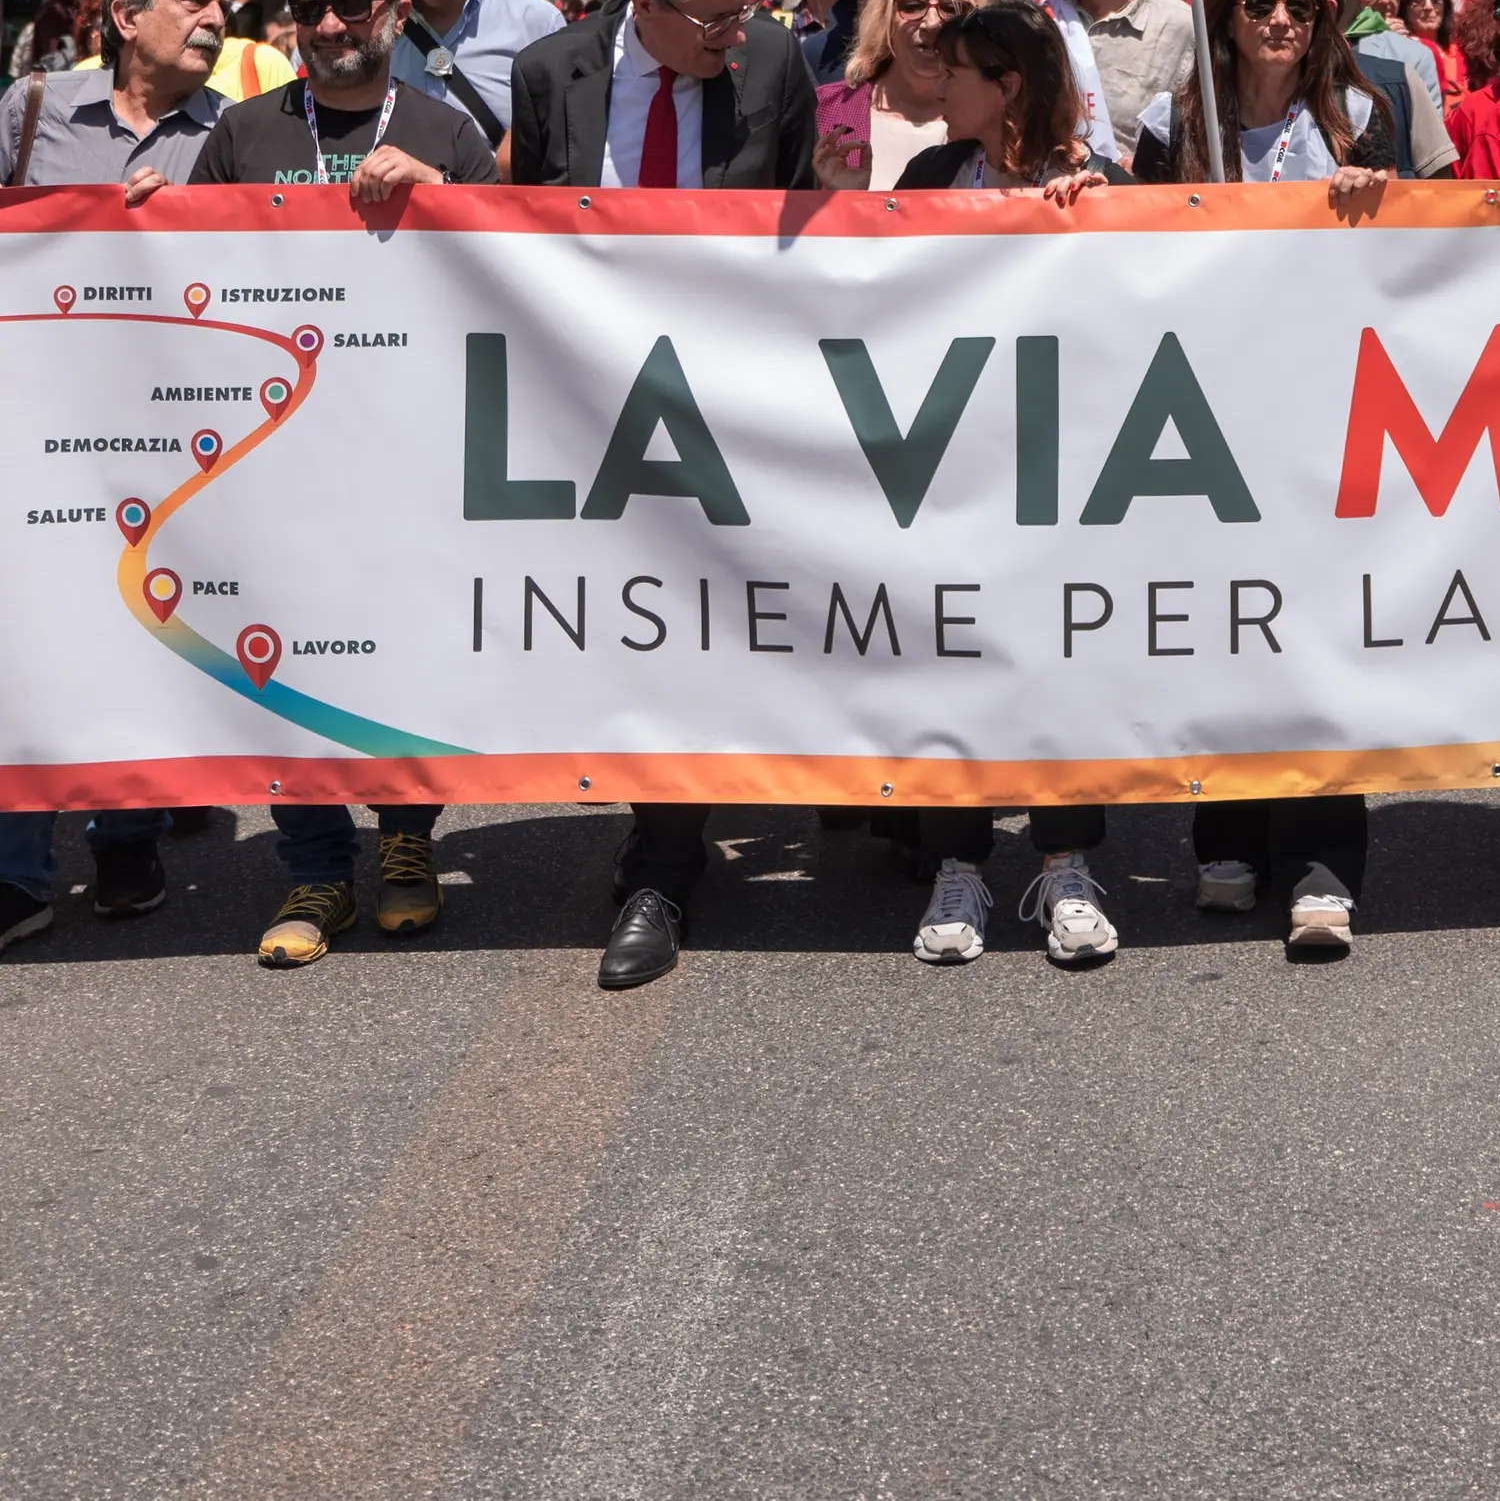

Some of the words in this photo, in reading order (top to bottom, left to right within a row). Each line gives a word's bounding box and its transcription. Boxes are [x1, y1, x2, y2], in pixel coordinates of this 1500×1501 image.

[321, 154, 366, 171] THE
[274, 169, 352, 184] NORT
[83, 286, 152, 301] DIRITTI
[221, 287, 345, 302] ISTRUZIONE
[333, 332, 408, 348] SALARI
[150, 386, 252, 402] AMBIENTE
[464, 332, 751, 526] LA
[819, 331, 1261, 528] VIA
[45, 437, 182, 453] DEMOCRAZIA
[26, 506, 107, 525] SALUTE
[192, 580, 240, 597] PACE
[472, 575, 982, 659] INSIEME
[1063, 579, 1283, 659] PER
[1362, 569, 1492, 649] LA
[292, 639, 377, 656] LAVORO
